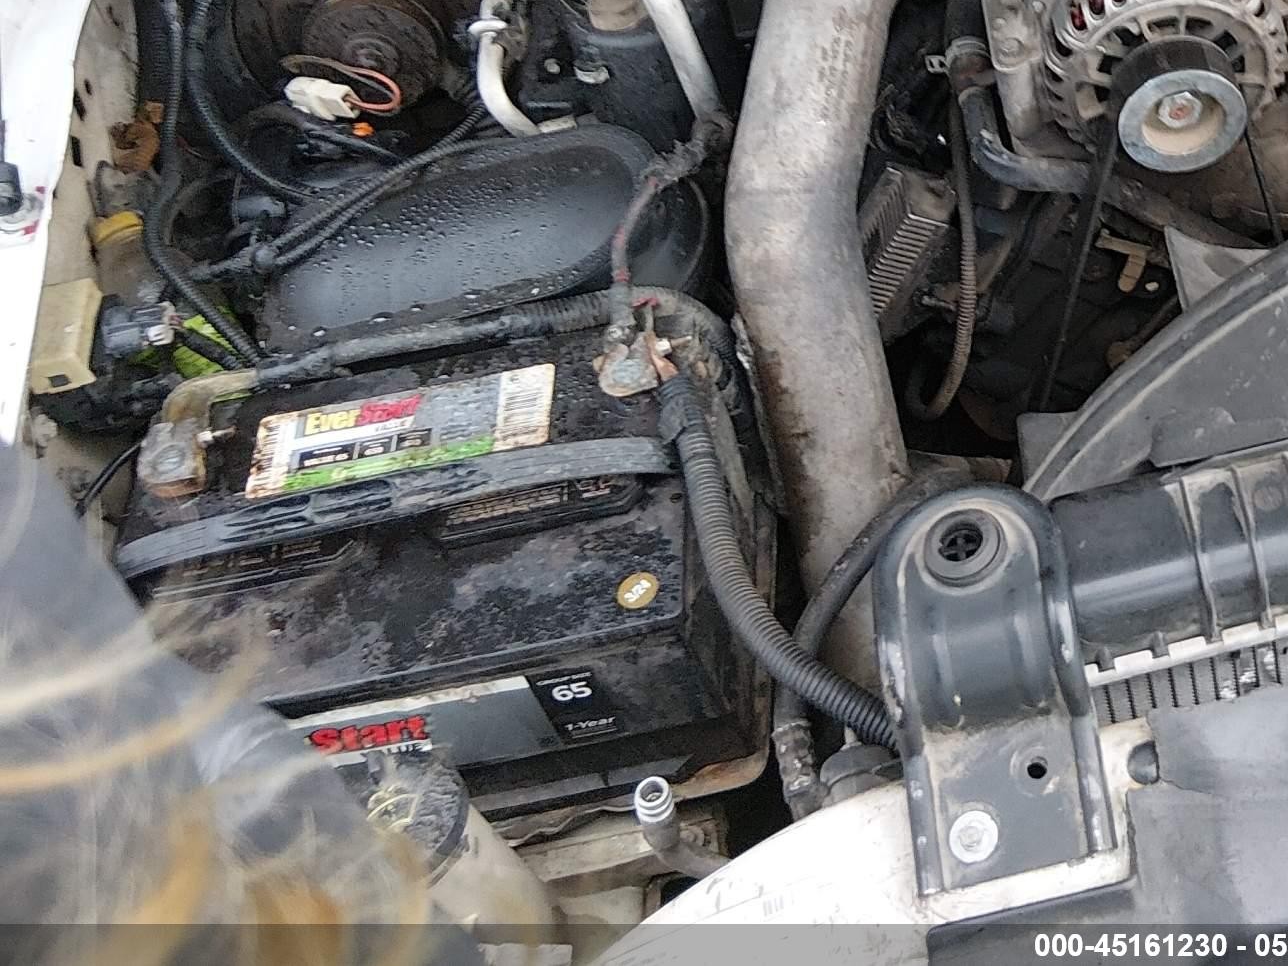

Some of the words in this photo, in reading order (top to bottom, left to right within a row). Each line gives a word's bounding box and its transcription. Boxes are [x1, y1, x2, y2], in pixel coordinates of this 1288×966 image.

[304, 395, 421, 434] EverStart
[551, 681, 593, 702] 65
[307, 715, 428, 754] Start
[564, 716, 616, 731] 1-Year
